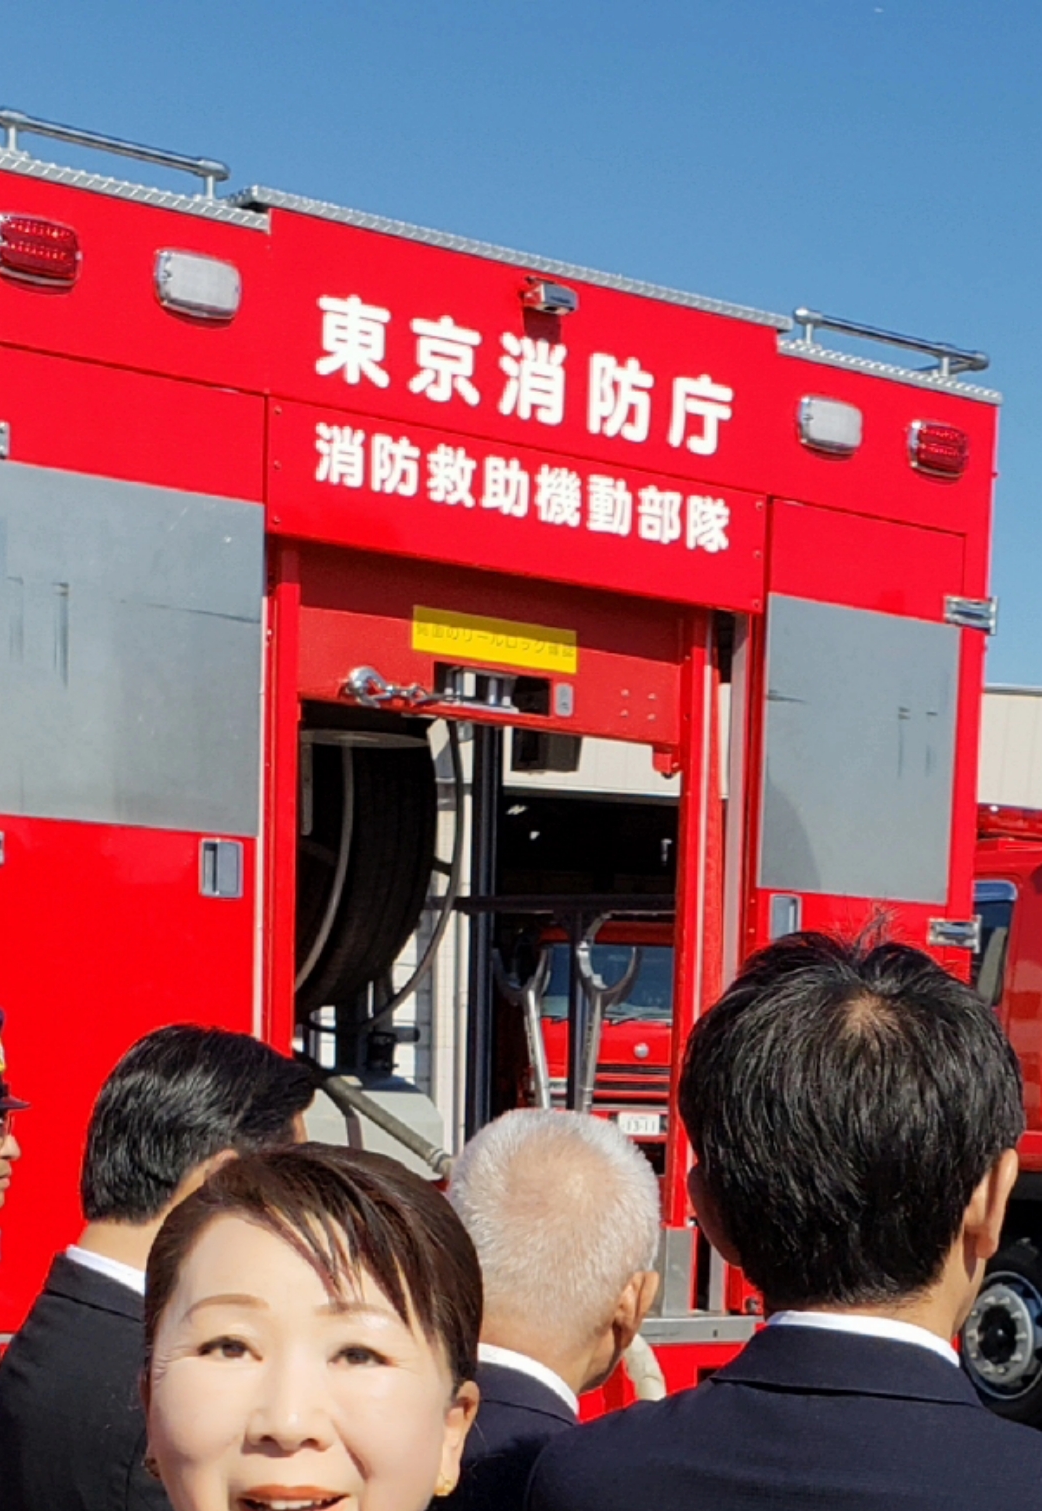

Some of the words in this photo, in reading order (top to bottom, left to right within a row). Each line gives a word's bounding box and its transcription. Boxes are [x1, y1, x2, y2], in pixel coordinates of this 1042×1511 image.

[314, 294, 734, 456] 東京消防庁
[314, 421, 730, 553] 消防救助機動部隊
